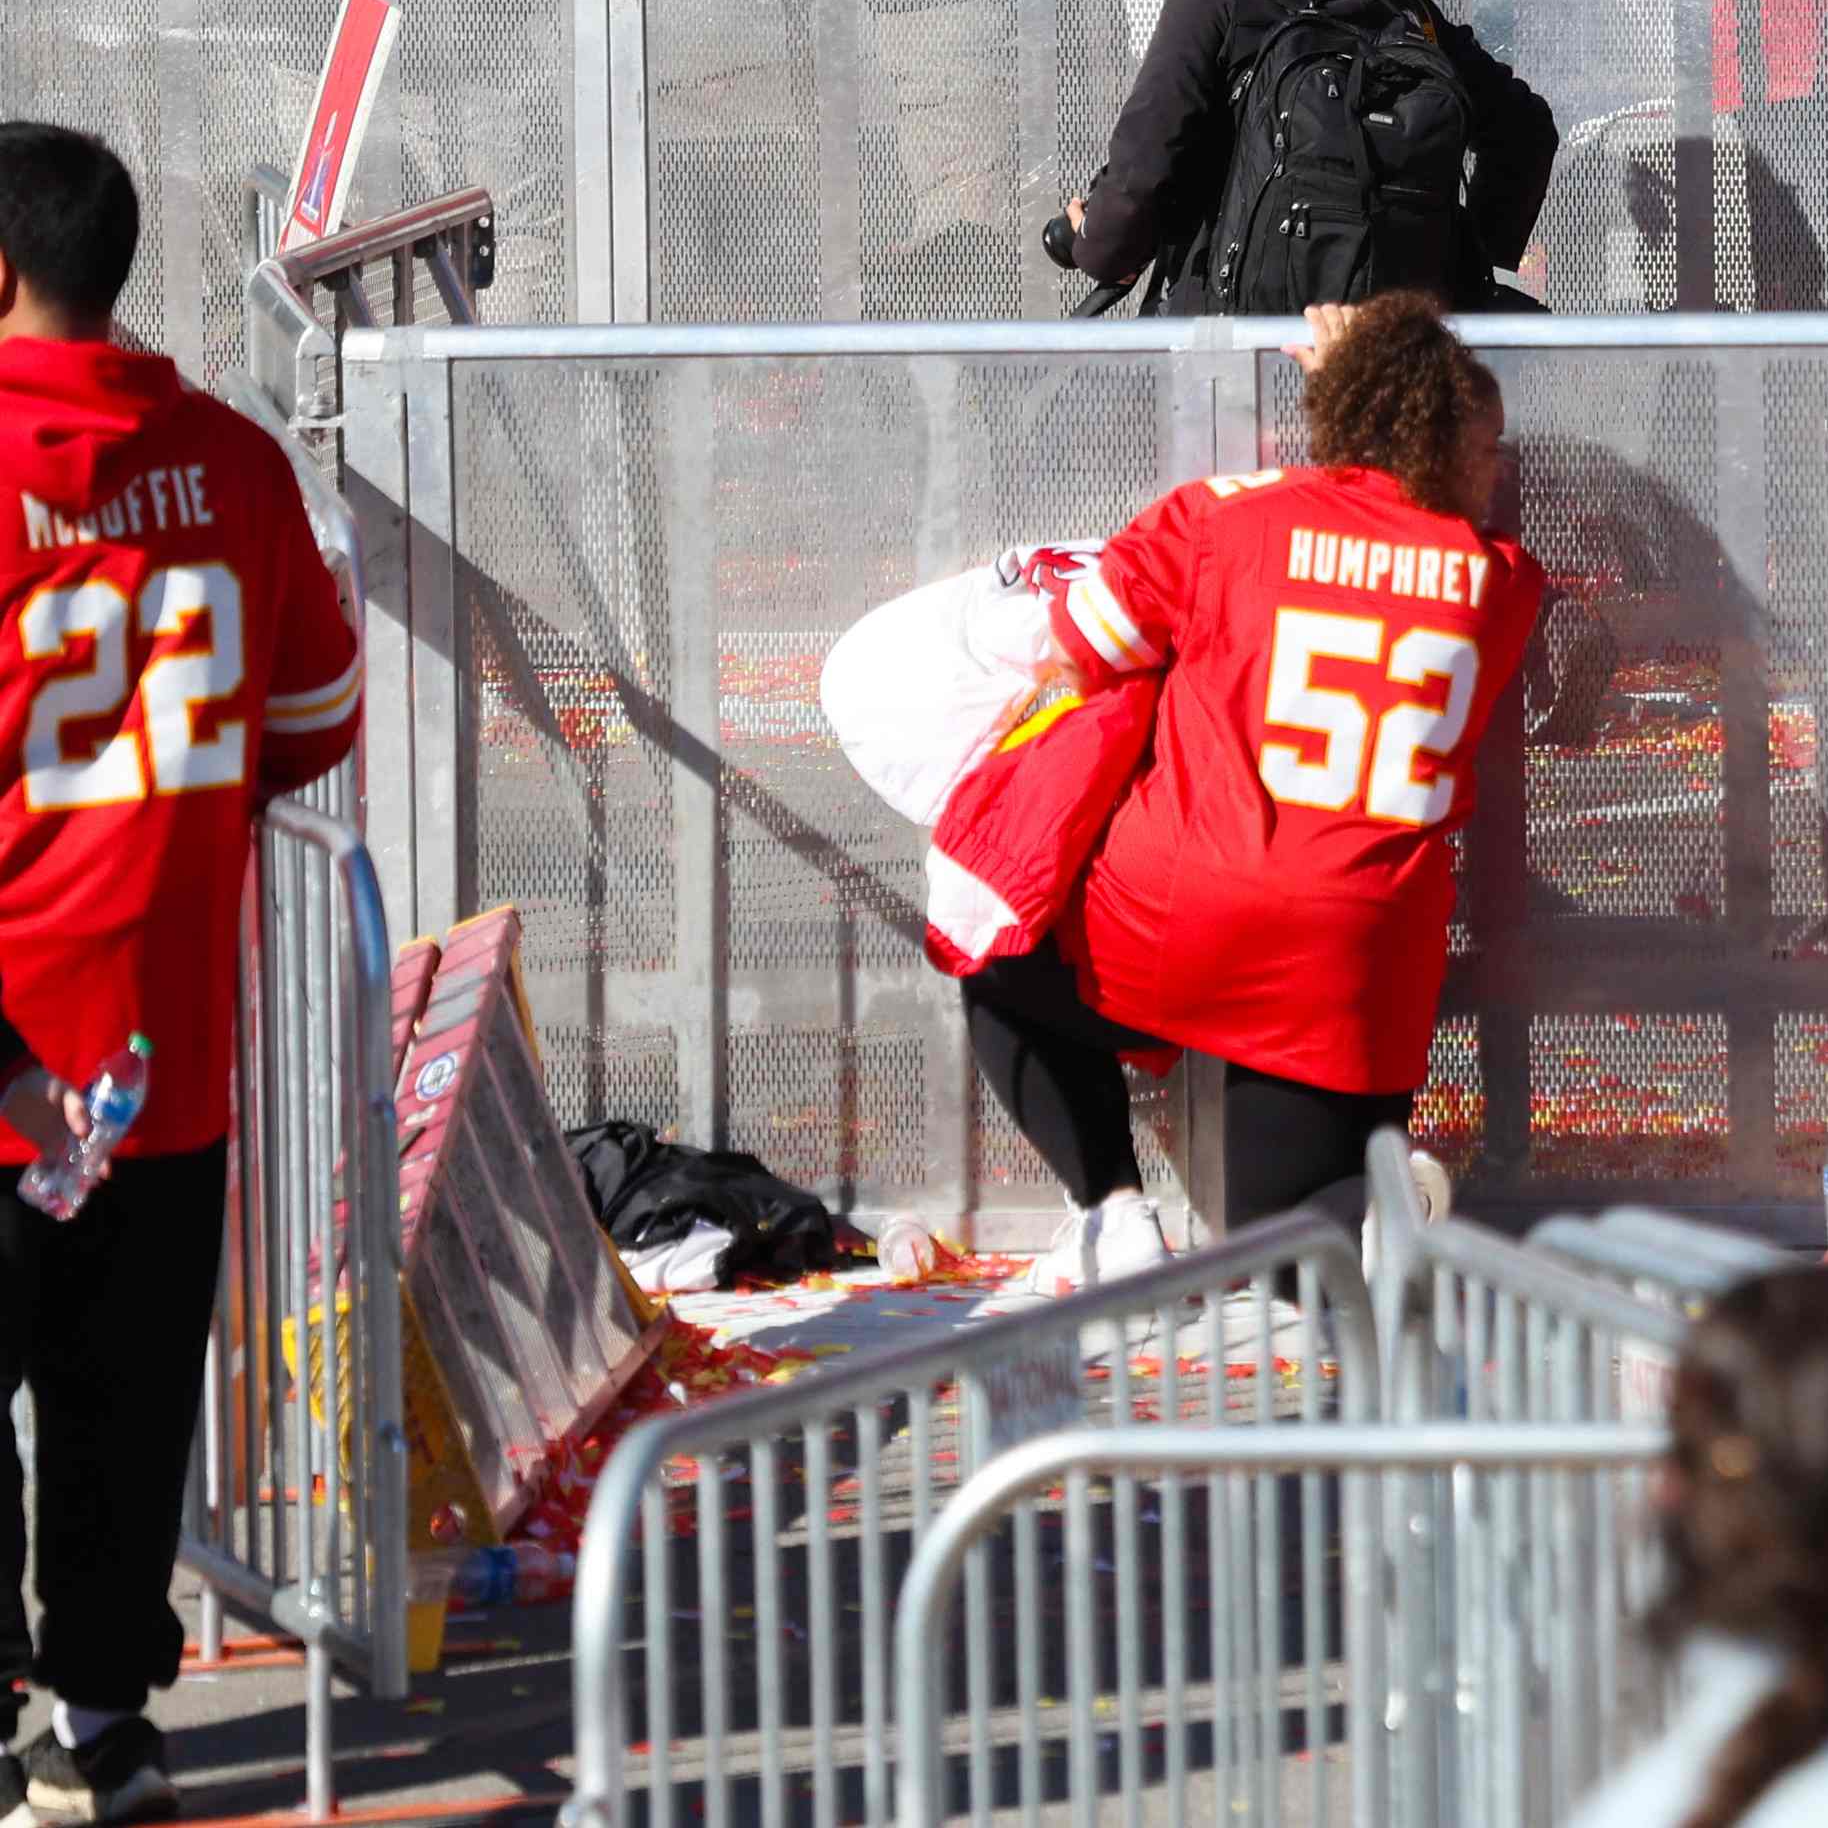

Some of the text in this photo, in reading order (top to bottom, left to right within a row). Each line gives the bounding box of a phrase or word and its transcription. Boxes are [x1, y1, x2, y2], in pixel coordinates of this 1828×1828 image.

[1287, 527, 1489, 610] HUMPHREY
[18, 562, 248, 813] 22
[1257, 605, 1481, 828] 52
